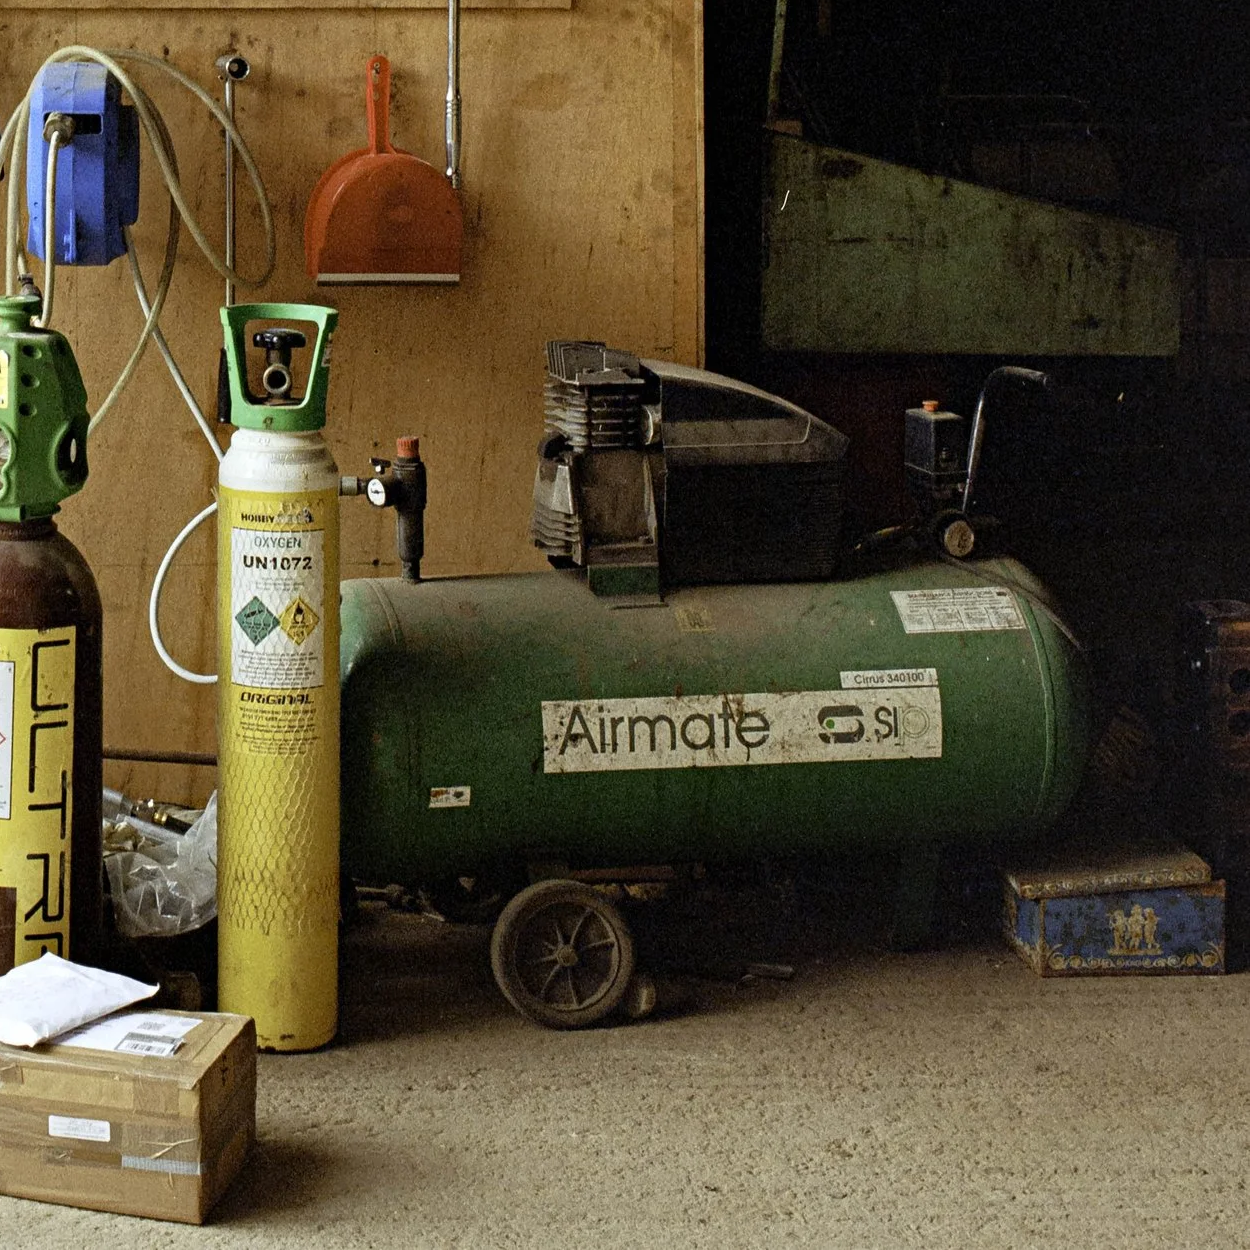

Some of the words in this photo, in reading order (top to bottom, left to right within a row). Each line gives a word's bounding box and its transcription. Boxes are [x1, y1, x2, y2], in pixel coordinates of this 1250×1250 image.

[254, 536, 302, 549] OXYGEN
[243, 555, 313, 570] UN1072
[853, 674, 885, 685] Cirrus
[887, 672, 925, 684] 340100
[558, 700, 771, 756] Airmate
